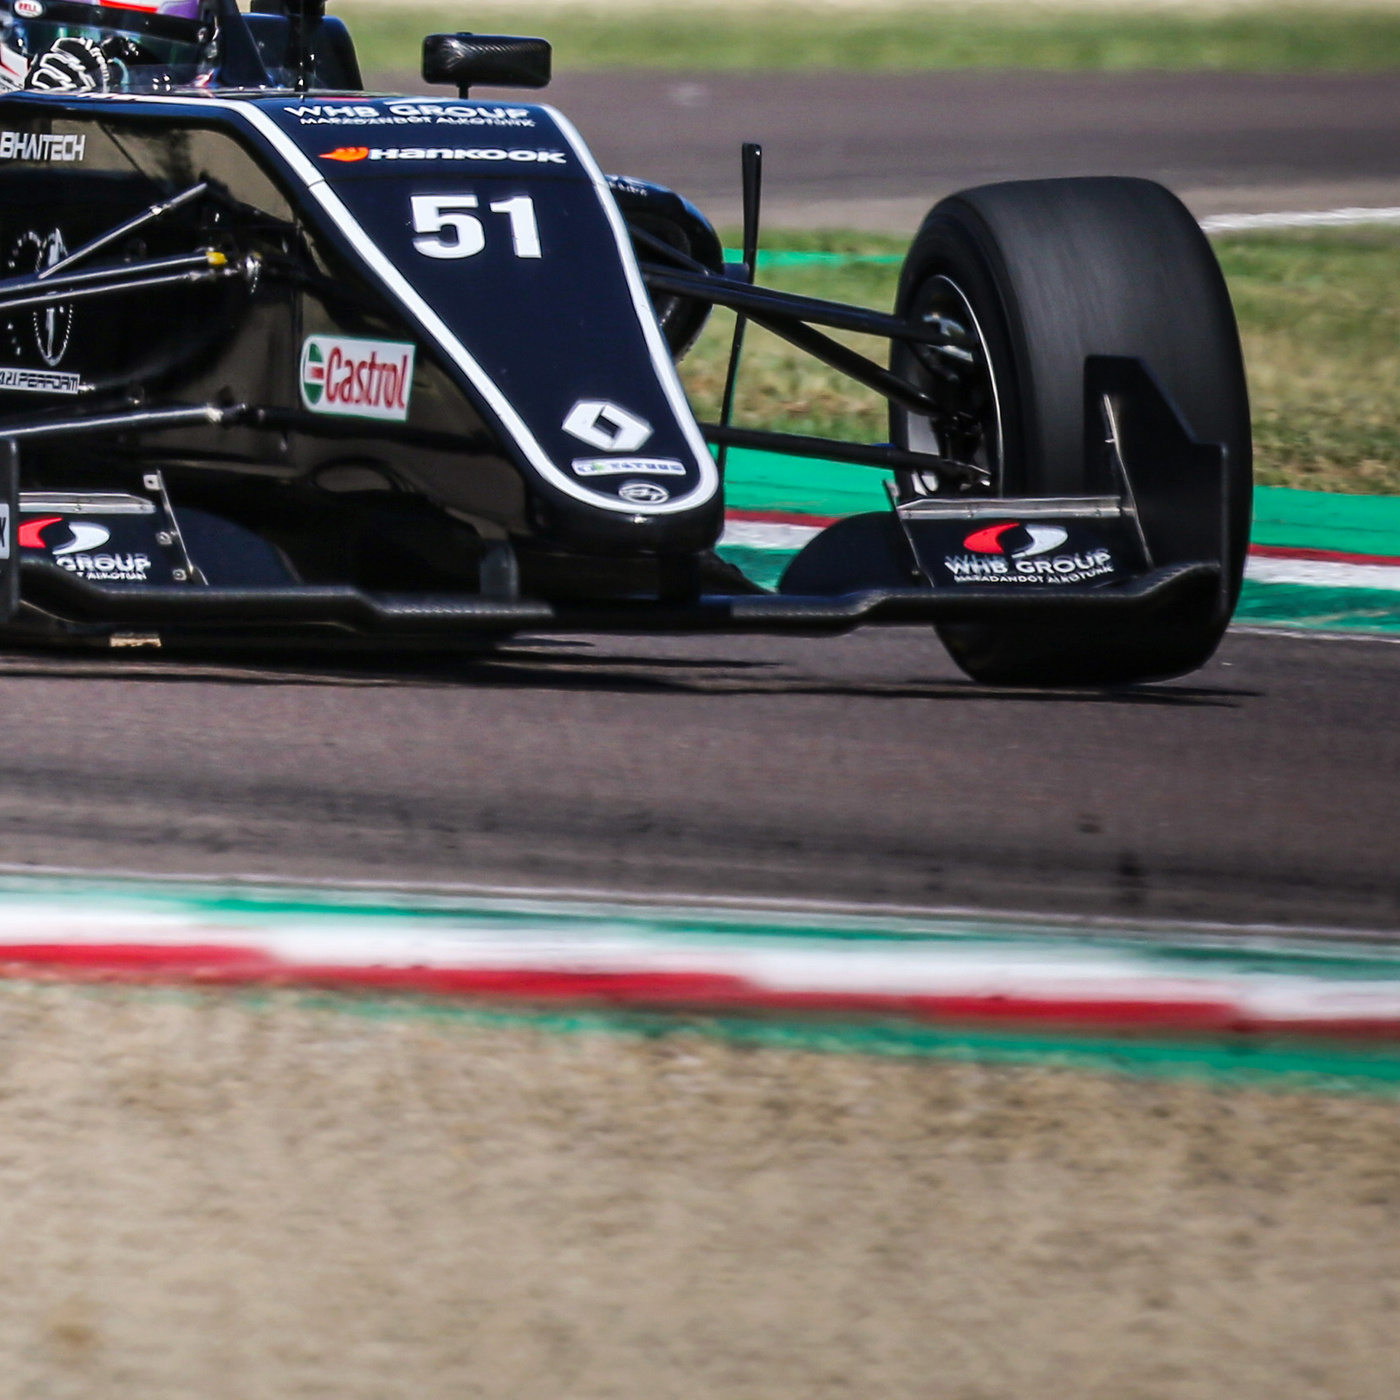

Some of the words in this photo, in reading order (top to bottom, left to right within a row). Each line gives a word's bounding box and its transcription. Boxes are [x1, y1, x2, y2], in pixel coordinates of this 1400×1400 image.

[283, 104, 380, 118] WHB
[388, 104, 529, 120] GROUP
[410, 193, 542, 260] 51
[325, 346, 406, 409] Castrol
[55, 553, 152, 573] GROUP
[944, 556, 1009, 575] WHB
[1015, 548, 1112, 574] GROUP
